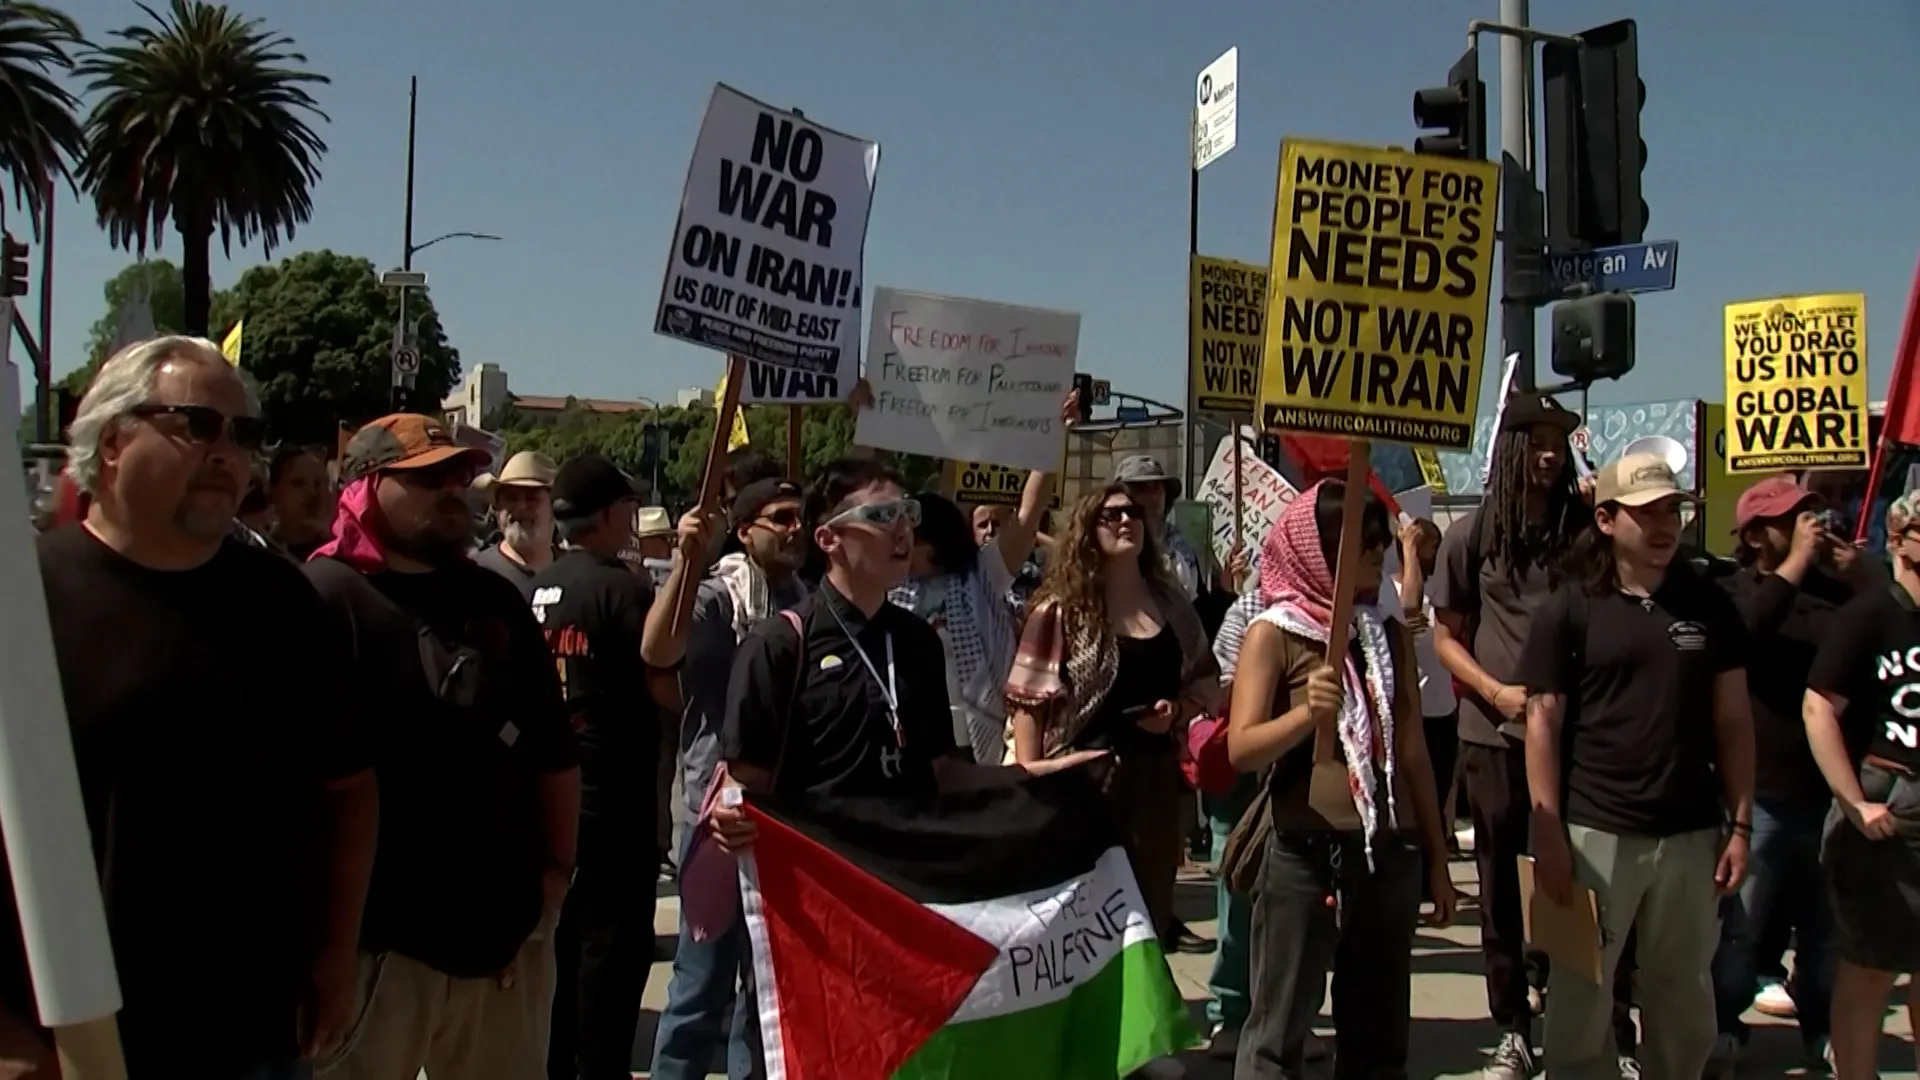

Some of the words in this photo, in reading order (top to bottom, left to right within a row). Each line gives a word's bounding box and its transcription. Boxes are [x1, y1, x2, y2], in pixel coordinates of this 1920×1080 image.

[750, 111, 823, 183] NO
[1295, 156, 1414, 196] MONEY
[1422, 169, 1484, 205] FOR
[718, 157, 837, 248] WAR
[1292, 188, 1482, 243] PEOPLE'S
[682, 224, 741, 277] ON
[745, 243, 852, 308] IRAN!
[1201, 263, 1246, 284] MONEY
[1287, 227, 1478, 298] NEEDS
[1551, 254, 1626, 277] Veteran
[1643, 246, 1668, 270] Av
[674, 275, 699, 304] US
[700, 283, 735, 314] OUT
[735, 294, 758, 320] OF
[758, 301, 841, 341] MID-EAST
[1202, 303, 1264, 335] NEED
[1734, 322, 1760, 336] WE
[1764, 315, 1821, 334] WON'T
[1827, 314, 1856, 329] LET
[890, 311, 971, 350] FREEDOM
[979, 334, 1001, 353] FOR
[1282, 296, 1369, 348] NOT
[1378, 305, 1474, 360] WAR
[1735, 335, 1782, 356] YOU
[1791, 329, 1857, 352] DRAG
[882, 352, 950, 383] FREEDOM
[957, 367, 982, 386] FOR
[1203, 339, 1237, 366] NOT
[1736, 355, 1775, 383] US
[1786, 351, 1858, 378] INTO
[1282, 346, 1346, 398] W/
[1350, 351, 1470, 414] IRAN
[1736, 385, 1859, 416] GLOBAL
[1273, 408, 1461, 442] ANSWERCOALITION.ORG
[1735, 413, 1860, 452] WAR!
[962, 470, 991, 490] ON
[1207, 477, 1274, 529] AGANST
